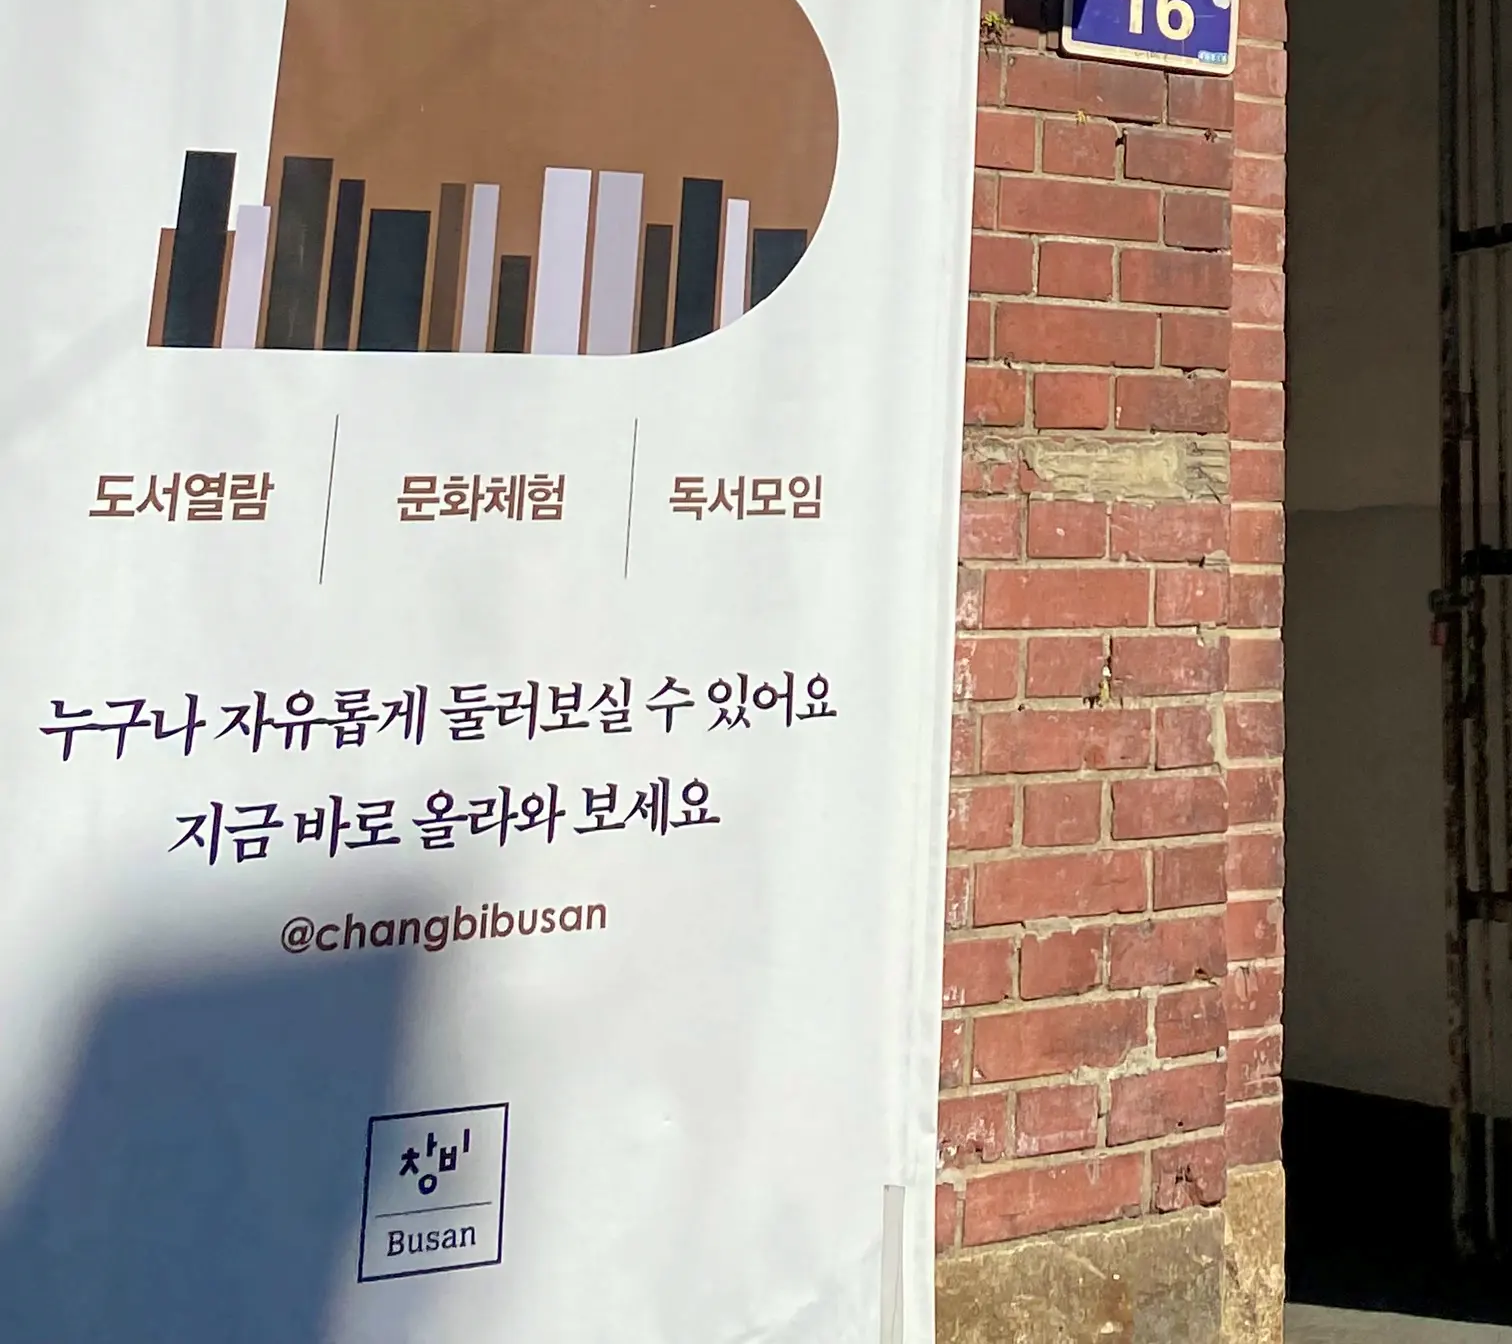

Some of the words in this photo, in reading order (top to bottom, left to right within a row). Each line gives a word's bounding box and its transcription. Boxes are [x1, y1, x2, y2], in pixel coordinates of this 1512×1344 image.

[88, 471, 275, 522] 도서열람
[396, 473, 566, 522] 문화체험
[668, 474, 824, 521] 독서모임
[38, 692, 207, 762] 누구나
[213, 684, 428, 754] 자유롭게
[439, 675, 633, 742] 둘러보실
[645, 674, 696, 733] 수
[707, 670, 838, 732] 있어요
[167, 797, 285, 867] 지금
[293, 794, 402, 858] 바로
[411, 783, 567, 851] 올라와
[573, 776, 721, 837] 보세요
[280, 900, 608, 955] @changbibusan
[398, 1127, 472, 1196] 창비
[385, 1223, 477, 1258] Busan
